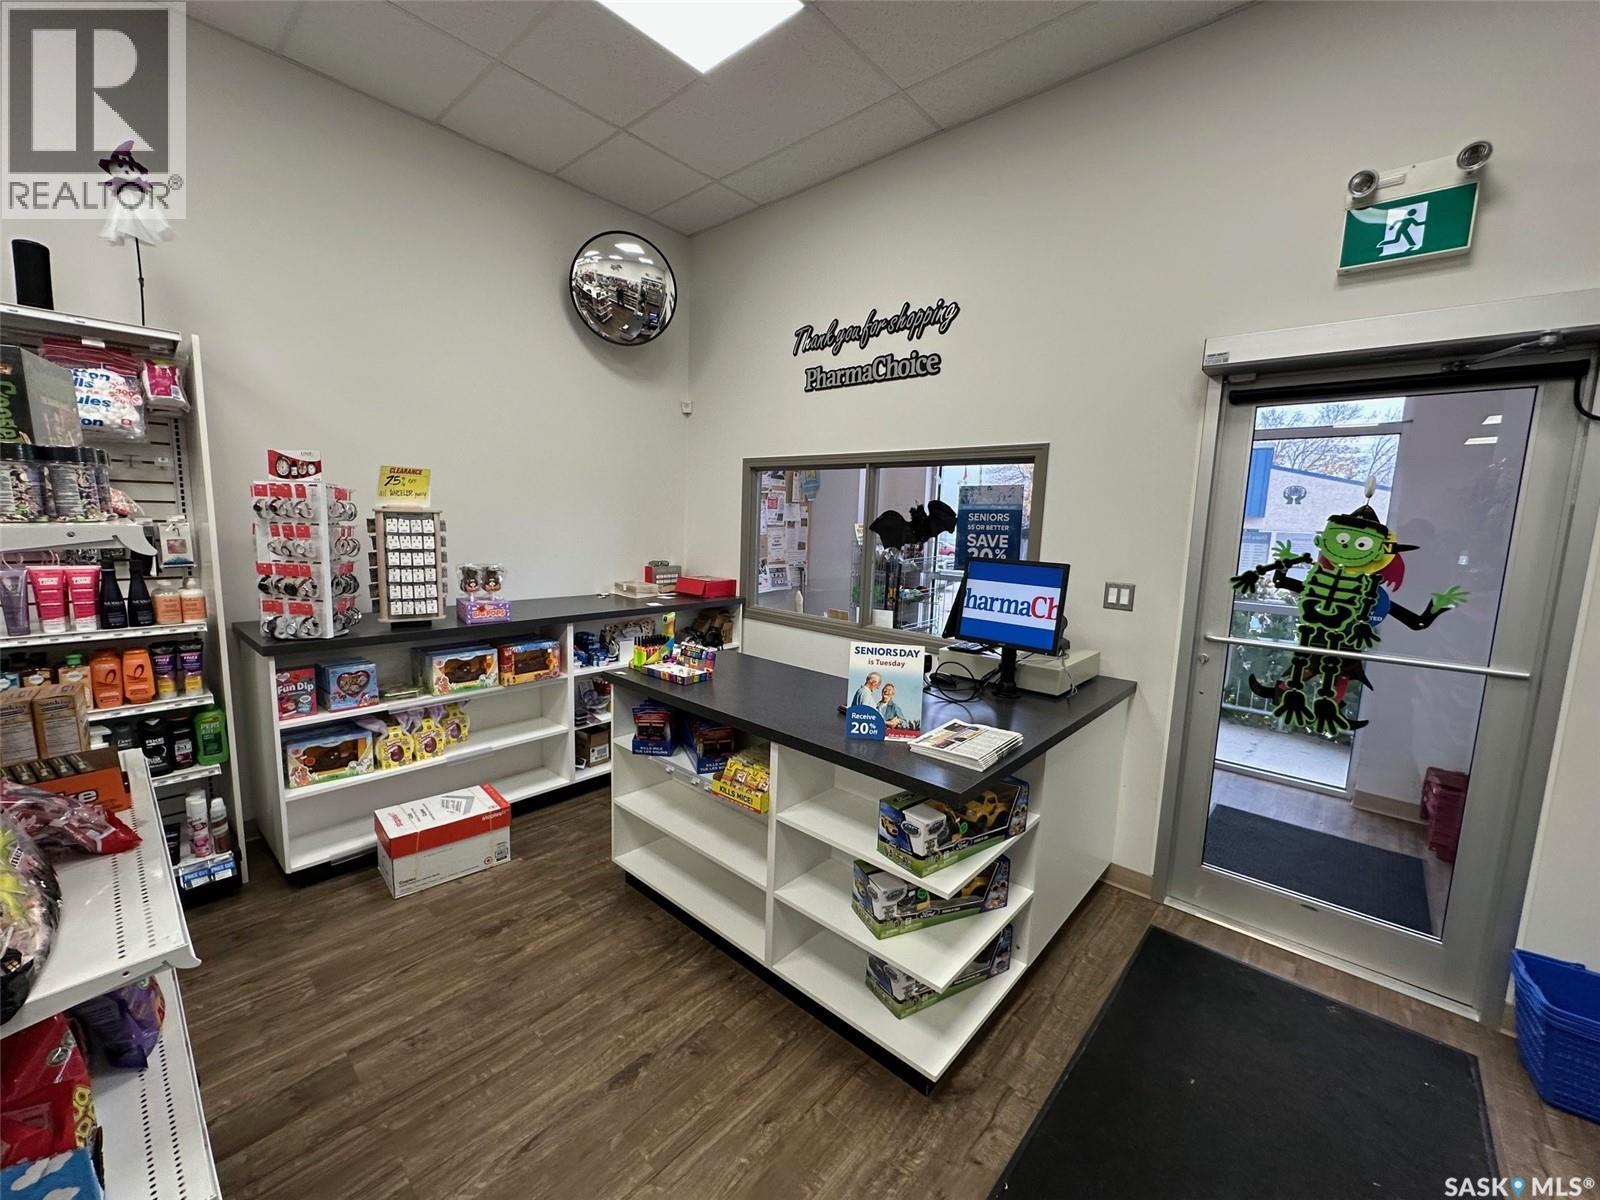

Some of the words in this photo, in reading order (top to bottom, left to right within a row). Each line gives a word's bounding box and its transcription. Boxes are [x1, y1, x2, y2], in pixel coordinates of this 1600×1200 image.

[793, 318, 839, 356] Thank
[832, 325, 861, 356] you
[859, 309, 888, 349] for
[886, 298, 960, 341] shopping
[804, 350, 942, 392] PharmaChoice
[389, 467, 424, 476] CLEARANCE
[968, 512, 1010, 522] SENIORS
[967, 533, 1009, 548] SAVE
[854, 646, 920, 659] SENIORSDAY
[876, 659, 906, 669] Tuesday
[277, 684, 296, 695] Fun
[297, 681, 314, 693] Dip
[851, 712, 877, 720] Receive
[719, 784, 736, 799] KILLS
